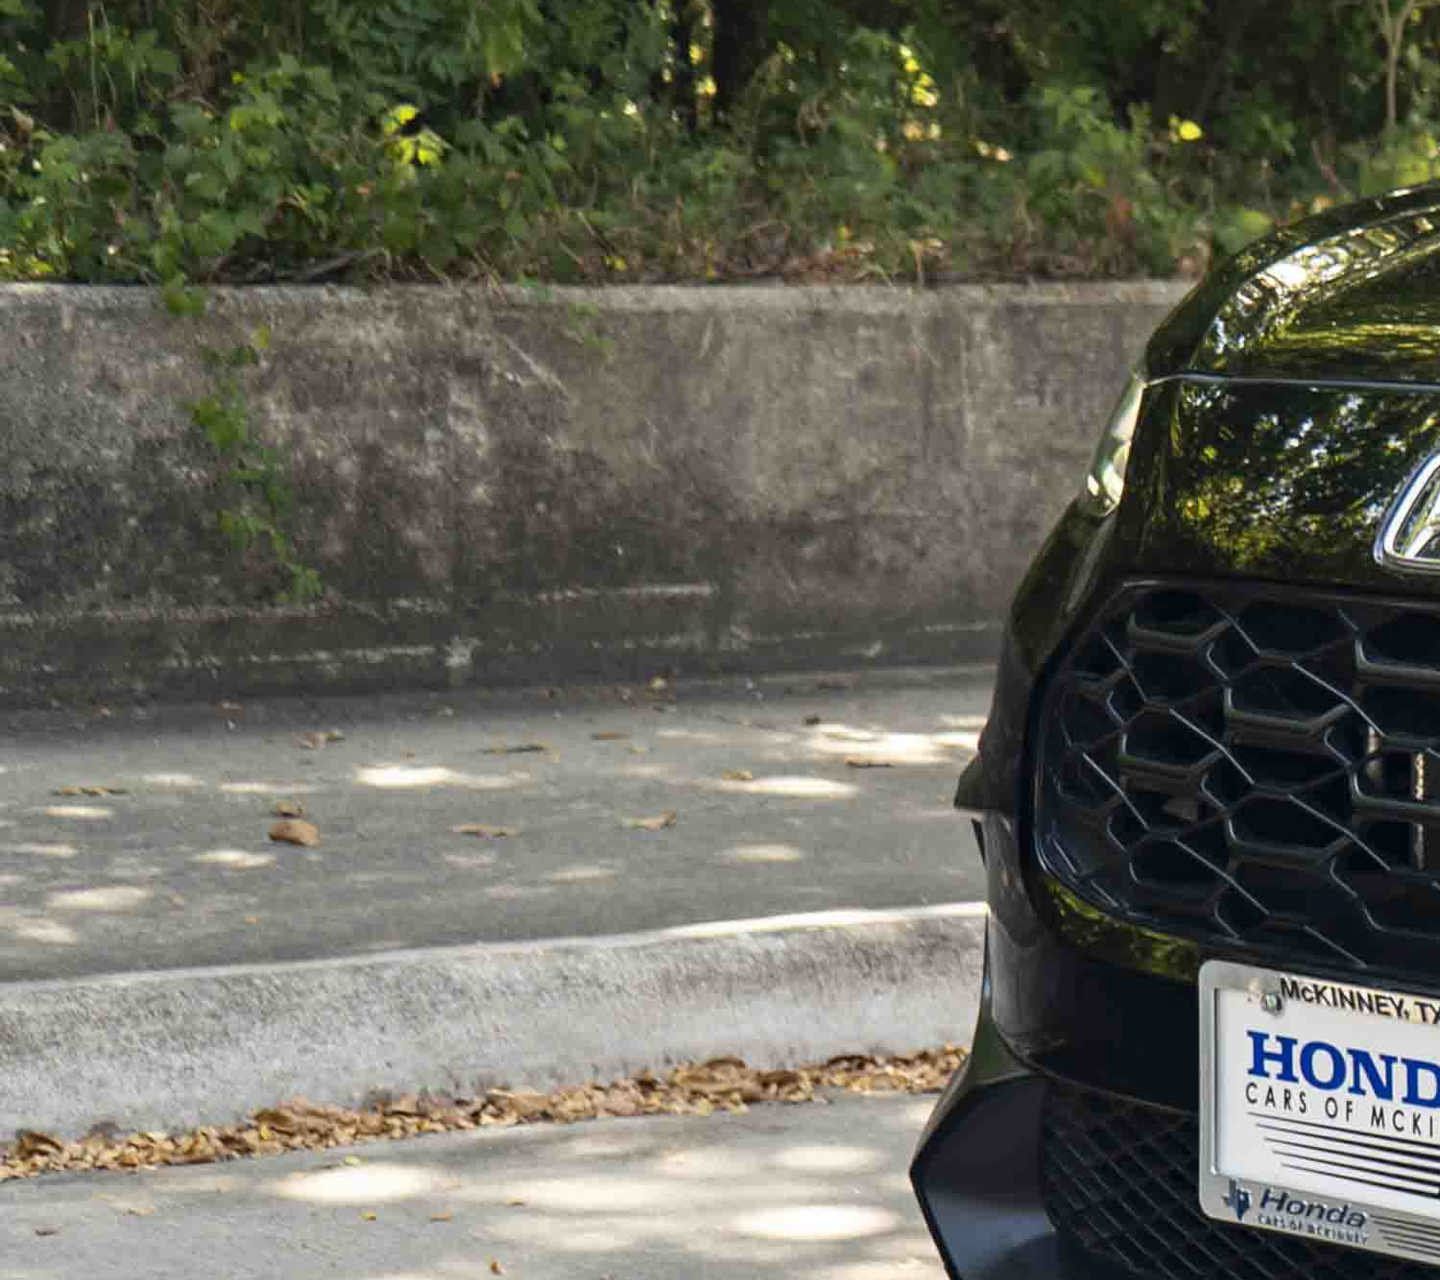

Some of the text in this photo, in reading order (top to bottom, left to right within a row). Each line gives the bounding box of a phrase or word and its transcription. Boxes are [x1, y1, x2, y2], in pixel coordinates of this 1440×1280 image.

[1279, 977, 1410, 1018] McKINNEY,
[1245, 1081, 1308, 1114] CARS
[1324, 1096, 1353, 1123] OF
[1259, 1188, 1368, 1229] Honda
